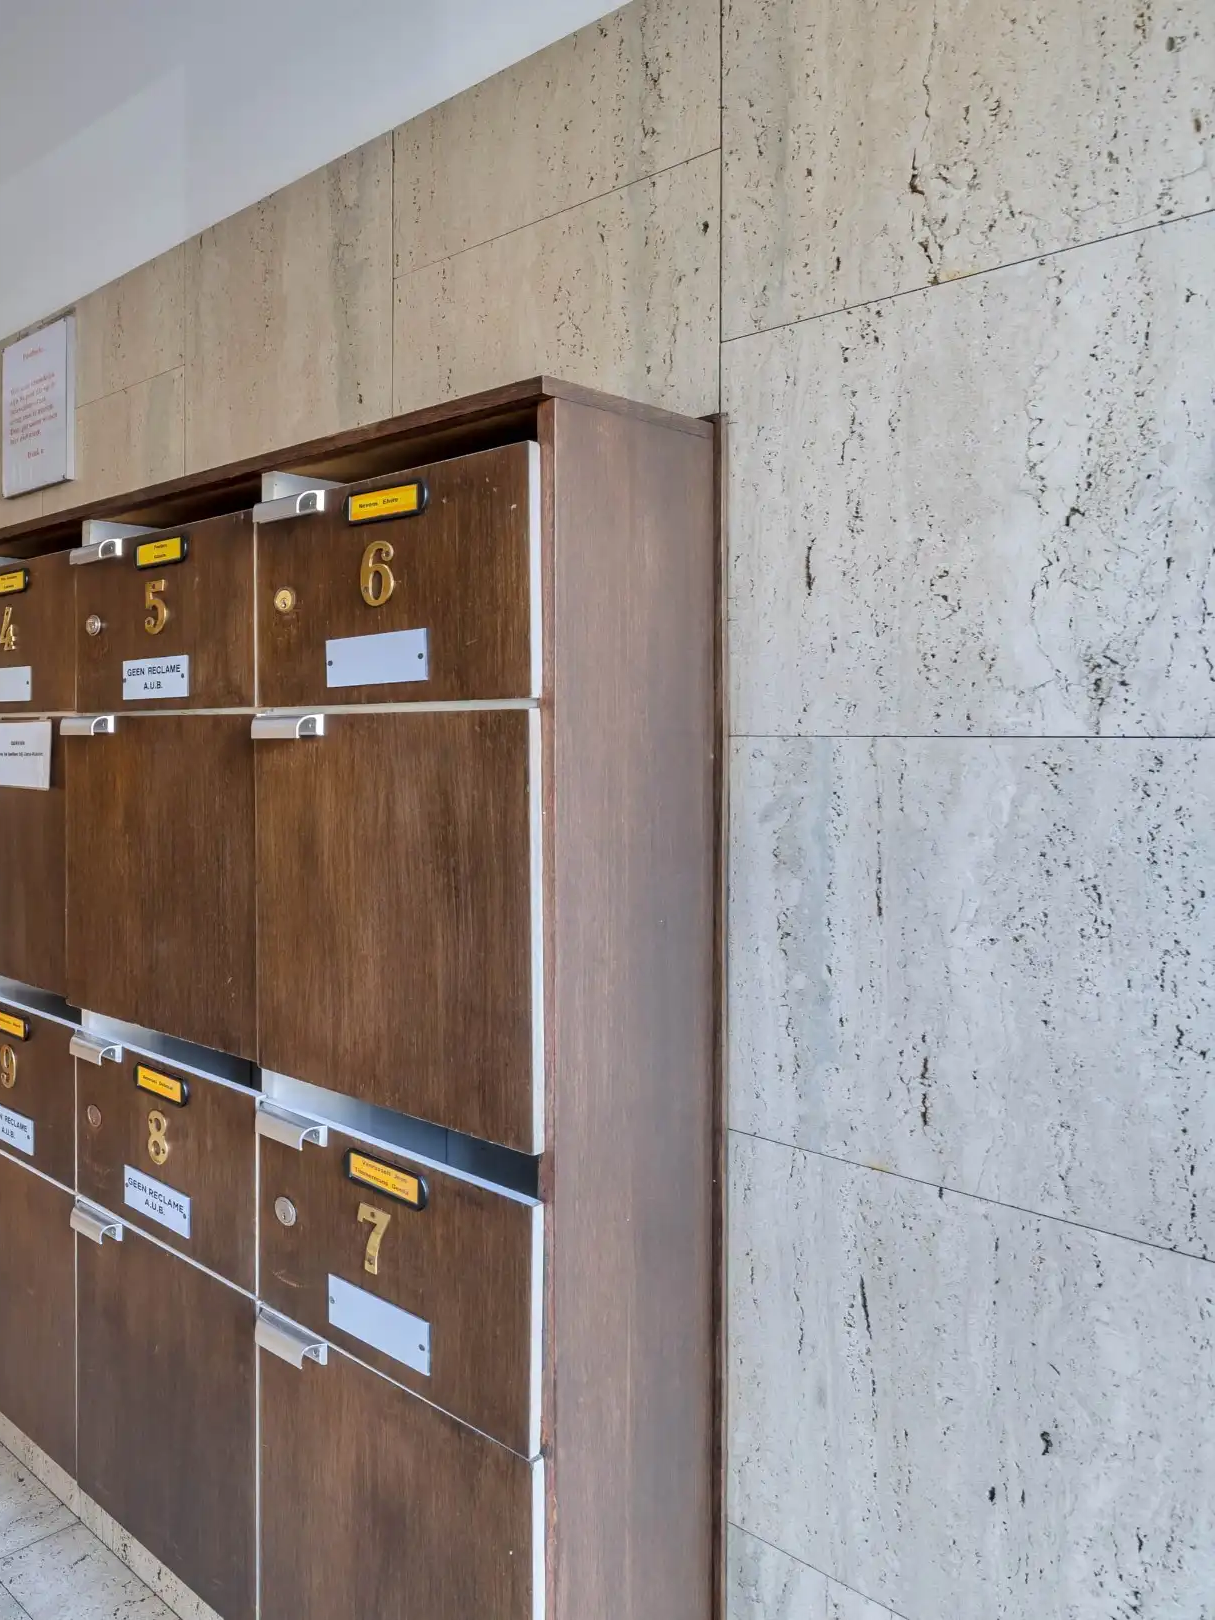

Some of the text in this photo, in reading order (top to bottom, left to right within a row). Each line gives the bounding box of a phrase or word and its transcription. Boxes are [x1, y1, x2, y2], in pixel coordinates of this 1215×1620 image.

[360, 540, 394, 607] 6
[144, 579, 168, 635] 5
[127, 664, 181, 677] GEEN RECLAME
[0, 1044, 16, 1088] 9
[4, 1115, 28, 1133] RECLAME
[148, 1109, 169, 1165] 8
[127, 1177, 184, 1214] GEEN RECLAME
[144, 1199, 165, 1216] A.U.B.
[357, 1202, 391, 1275] 7
